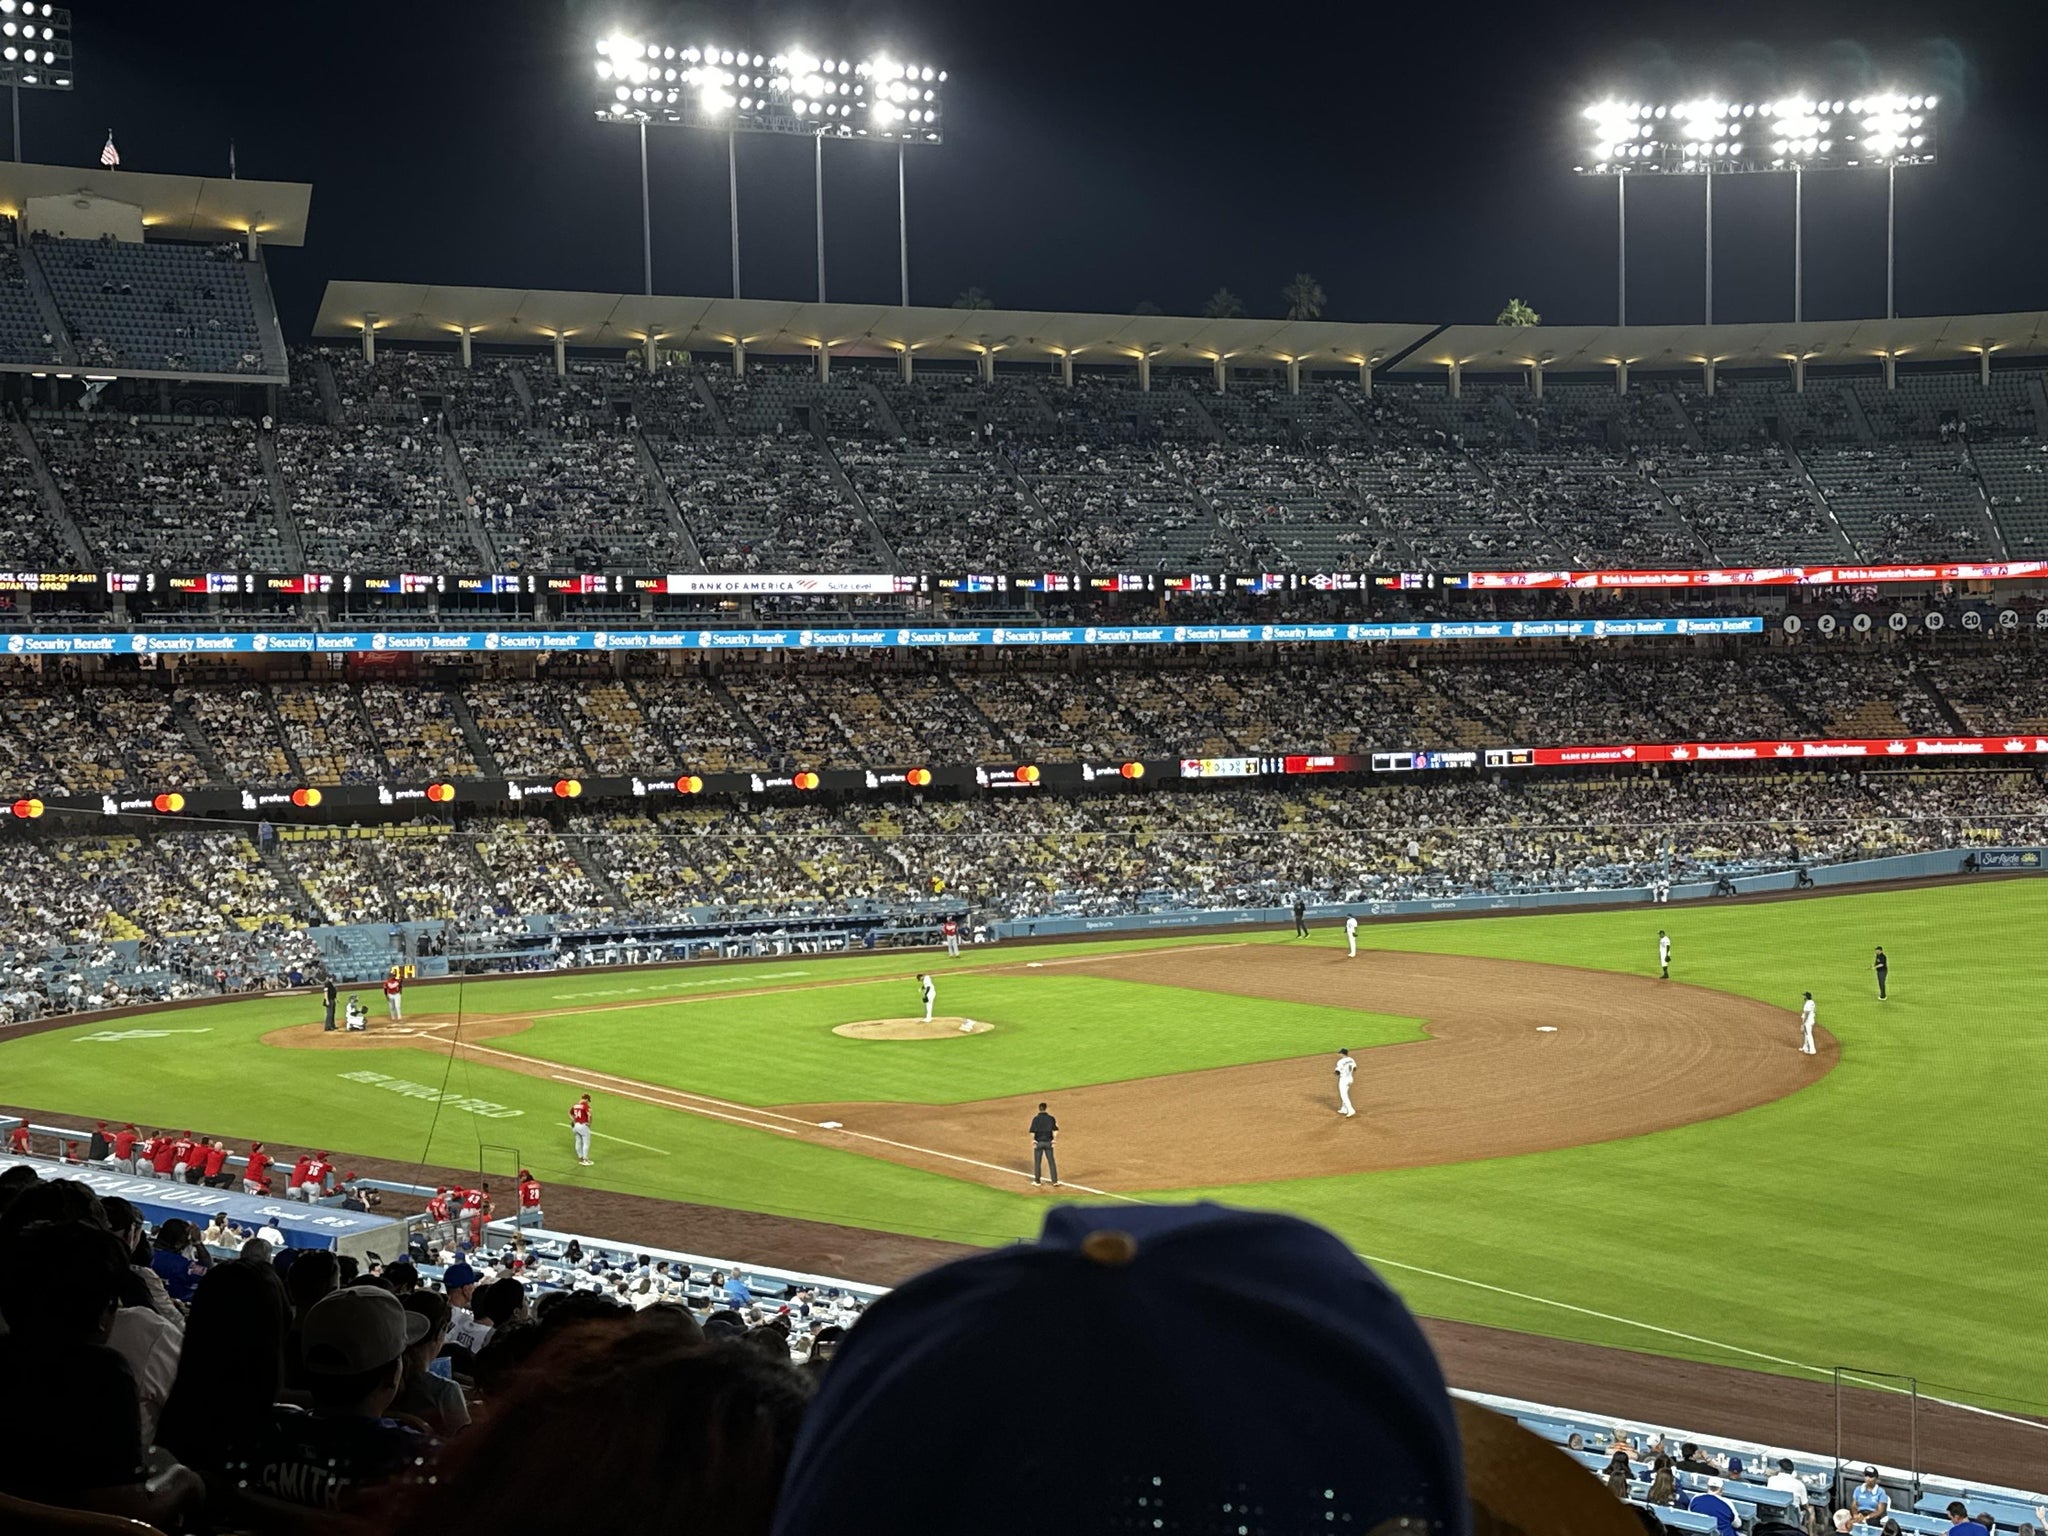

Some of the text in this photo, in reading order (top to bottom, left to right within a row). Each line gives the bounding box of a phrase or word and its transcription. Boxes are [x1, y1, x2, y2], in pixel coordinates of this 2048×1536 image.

[17, 573, 38, 582] CALL
[26, 582, 38, 591] TO
[170, 579, 196, 587] FINAL
[268, 580, 293, 588] FINAL
[366, 579, 390, 588] FINAL
[459, 580, 482, 588] FINAL
[549, 580, 571, 588] FINAL
[636, 579, 657, 588] FINAL
[691, 582, 794, 590] BANK OF AMERICA
[939, 579, 959, 588] FINAL
[1016, 579, 1035, 587] FINAL
[1823, 618, 1831, 628] 2
[1858, 618, 1865, 627] 4
[1893, 617, 1904, 627] 14
[1930, 616, 1940, 626] 19
[1965, 615, 1978, 625] 20
[2001, 614, 2015, 624] 24
[1605, 624, 1635, 633] Security
[1688, 623, 1721, 632] Security
[1789, 619, 1795, 629] 1
[1273, 629, 1306, 638] Security
[1359, 628, 1391, 638] Security
[1442, 627, 1474, 636] Security
[1523, 625, 1554, 634] Security
[911, 634, 948, 642] Security
[1005, 632, 1041, 641] Security
[1097, 632, 1131, 642] Security
[1187, 630, 1220, 639] Security
[269, 638, 313, 648] Security
[388, 637, 431, 650] Security
[500, 637, 542, 647] Security
[608, 636, 648, 648] Security
[713, 635, 750, 645] Security
[813, 634, 851, 645] Security
[26, 639, 71, 650] Security
[149, 639, 194, 651] Security
